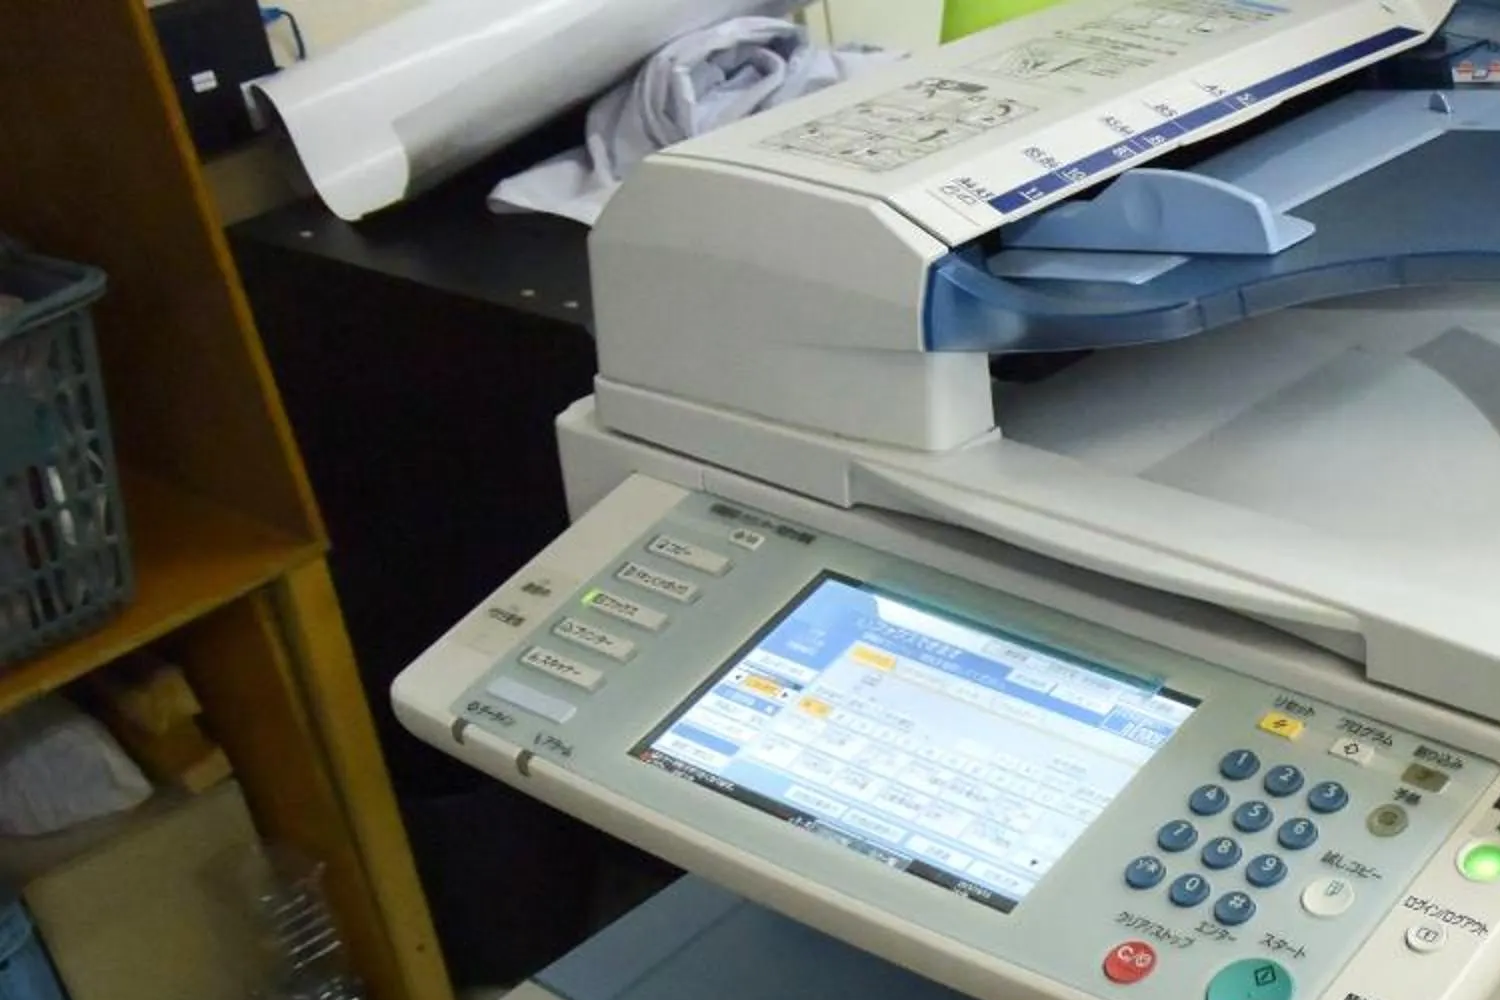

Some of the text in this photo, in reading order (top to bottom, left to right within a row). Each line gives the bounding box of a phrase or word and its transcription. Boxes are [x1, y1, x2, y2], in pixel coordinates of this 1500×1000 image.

[1336, 716, 1394, 747] プログラム
[1279, 766, 1295, 783] 2
[1323, 784, 1339, 799] 3
[1247, 804, 1264, 818] 5
[1292, 819, 1308, 835] 6
[1216, 838, 1233, 854] 8
[1263, 857, 1278, 872] 9
[1184, 877, 1200, 892] 0
[1258, 932, 1308, 960] スタート
